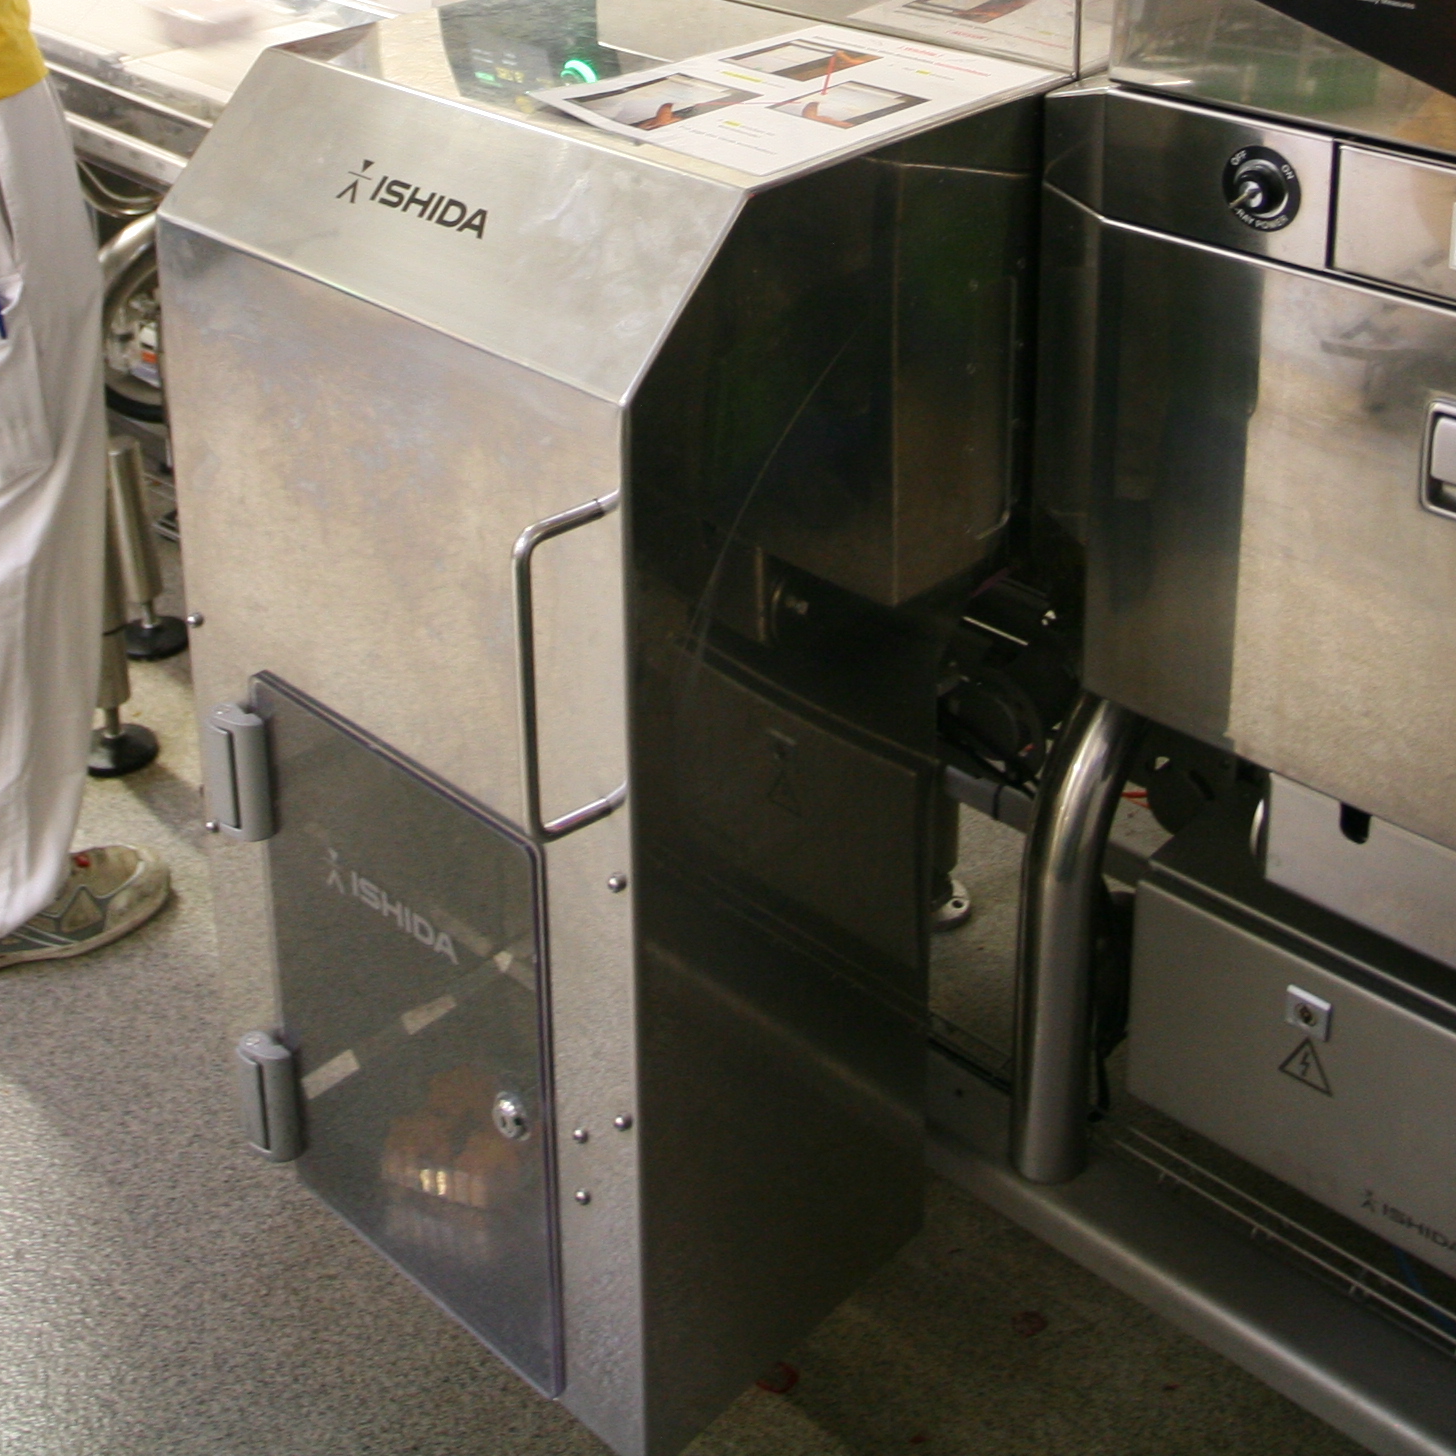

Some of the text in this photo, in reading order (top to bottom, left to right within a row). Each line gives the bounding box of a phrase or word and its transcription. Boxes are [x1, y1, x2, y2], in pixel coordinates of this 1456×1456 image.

[1230, 150, 1247, 165] OFF
[1281, 164, 1295, 180] ON
[369, 175, 488, 239] ISHIDA
[1255, 215, 1289, 230] POWER
[351, 871, 459, 965] ISHIDA
